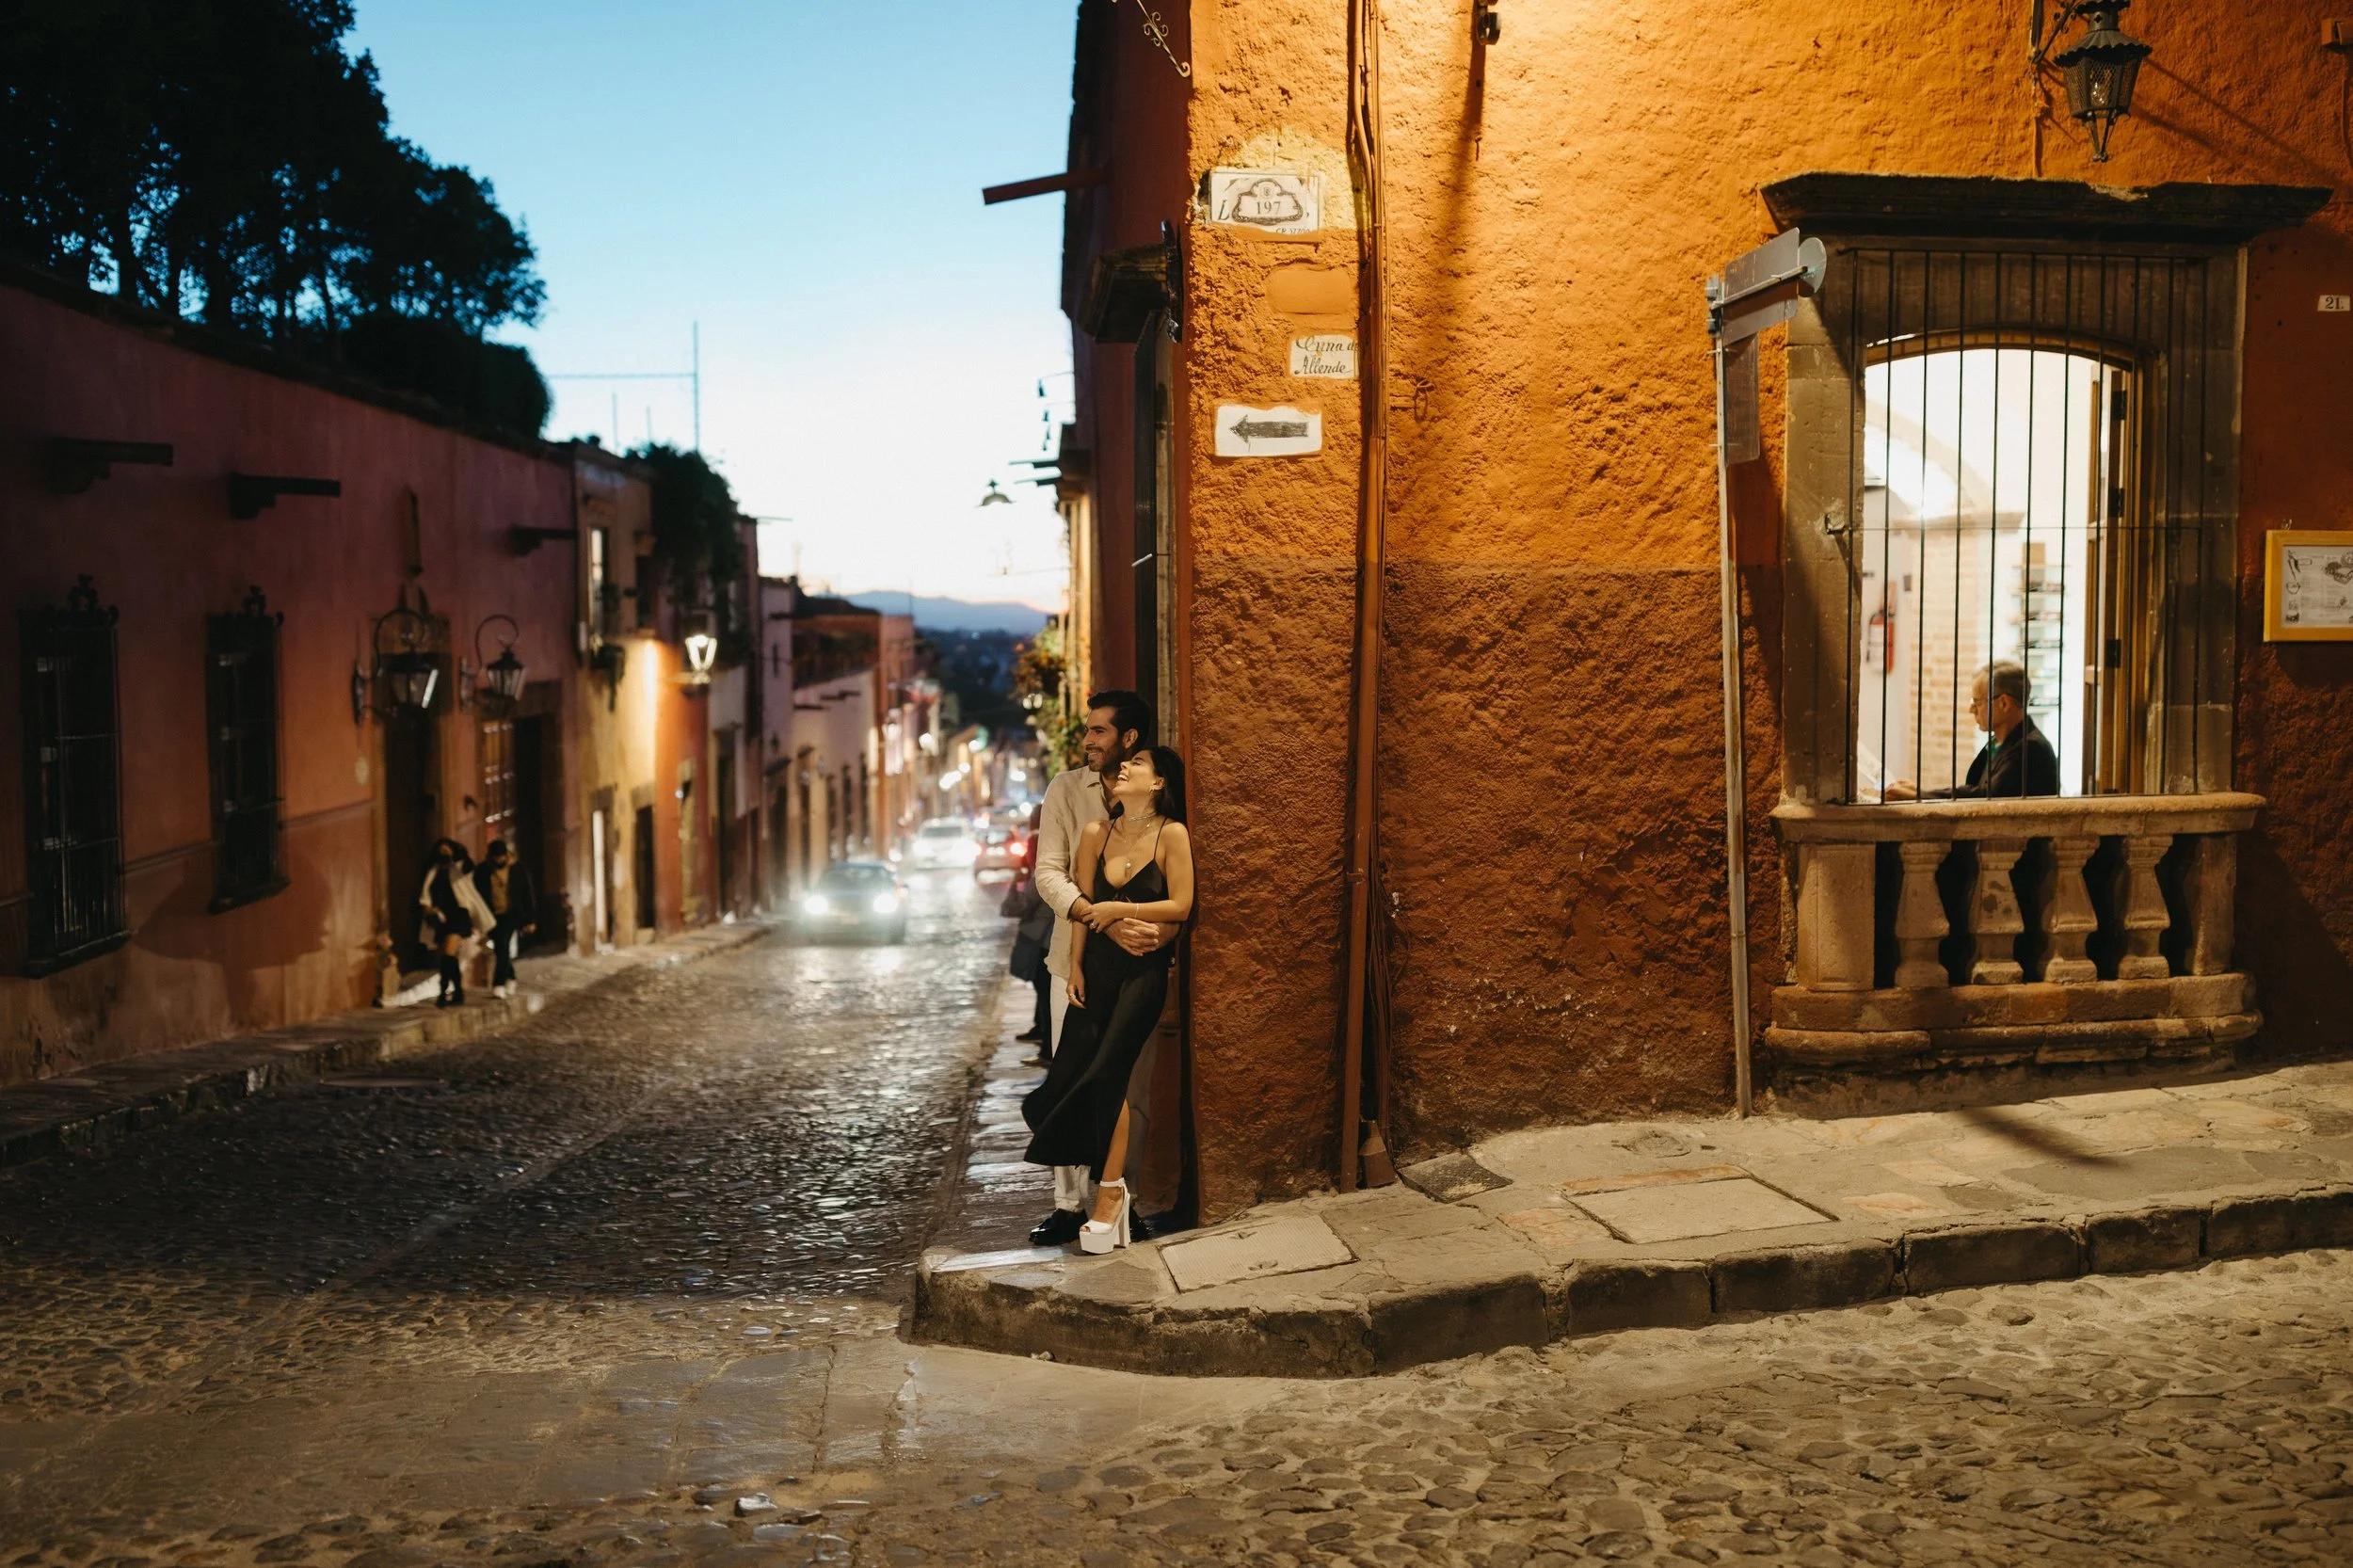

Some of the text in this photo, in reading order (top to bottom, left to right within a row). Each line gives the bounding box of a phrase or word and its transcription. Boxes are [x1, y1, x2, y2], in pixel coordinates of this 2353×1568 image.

[1257, 201, 1281, 215] 197
[1295, 335, 1344, 352] Cuna
[1294, 355, 1353, 375] Allende
